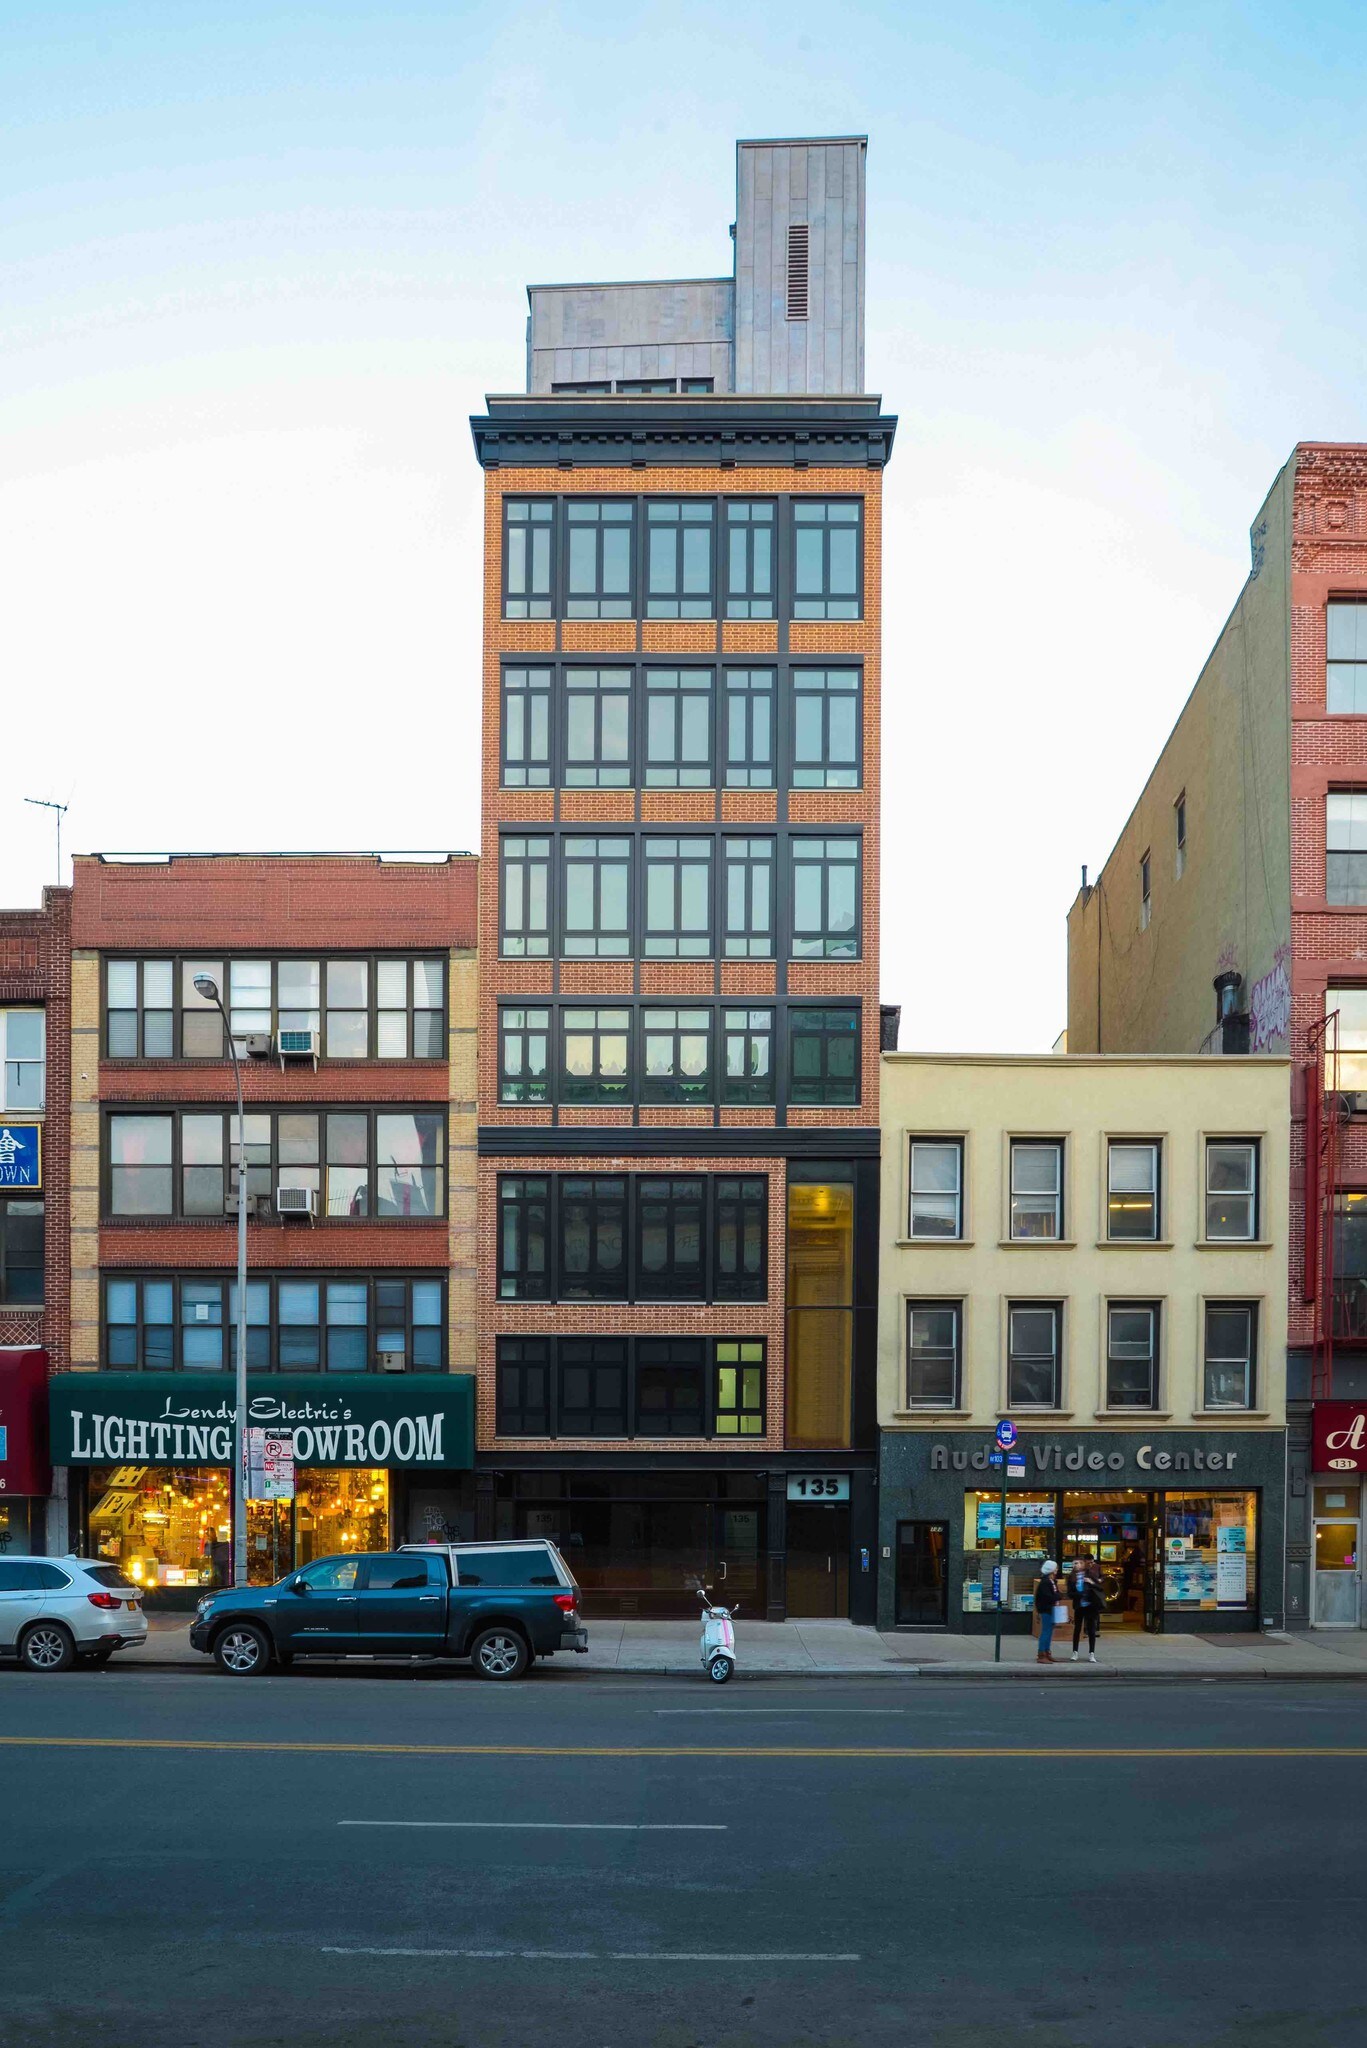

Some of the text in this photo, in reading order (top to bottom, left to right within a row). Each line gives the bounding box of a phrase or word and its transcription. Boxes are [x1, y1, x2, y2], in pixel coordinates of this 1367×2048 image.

[159, 1396, 352, 1424] Lendy Electric's
[70, 1410, 445, 1462] LIGHTING OWROOM
[1032, 1445, 1125, 1471] Video
[1136, 1445, 1238, 1471] Center
[1335, 1460, 1352, 1468] 131
[797, 1478, 839, 1496] 135
[247, 1505, 274, 1516] 137
[535, 1514, 552, 1523] 135
[733, 1514, 750, 1523] 135
